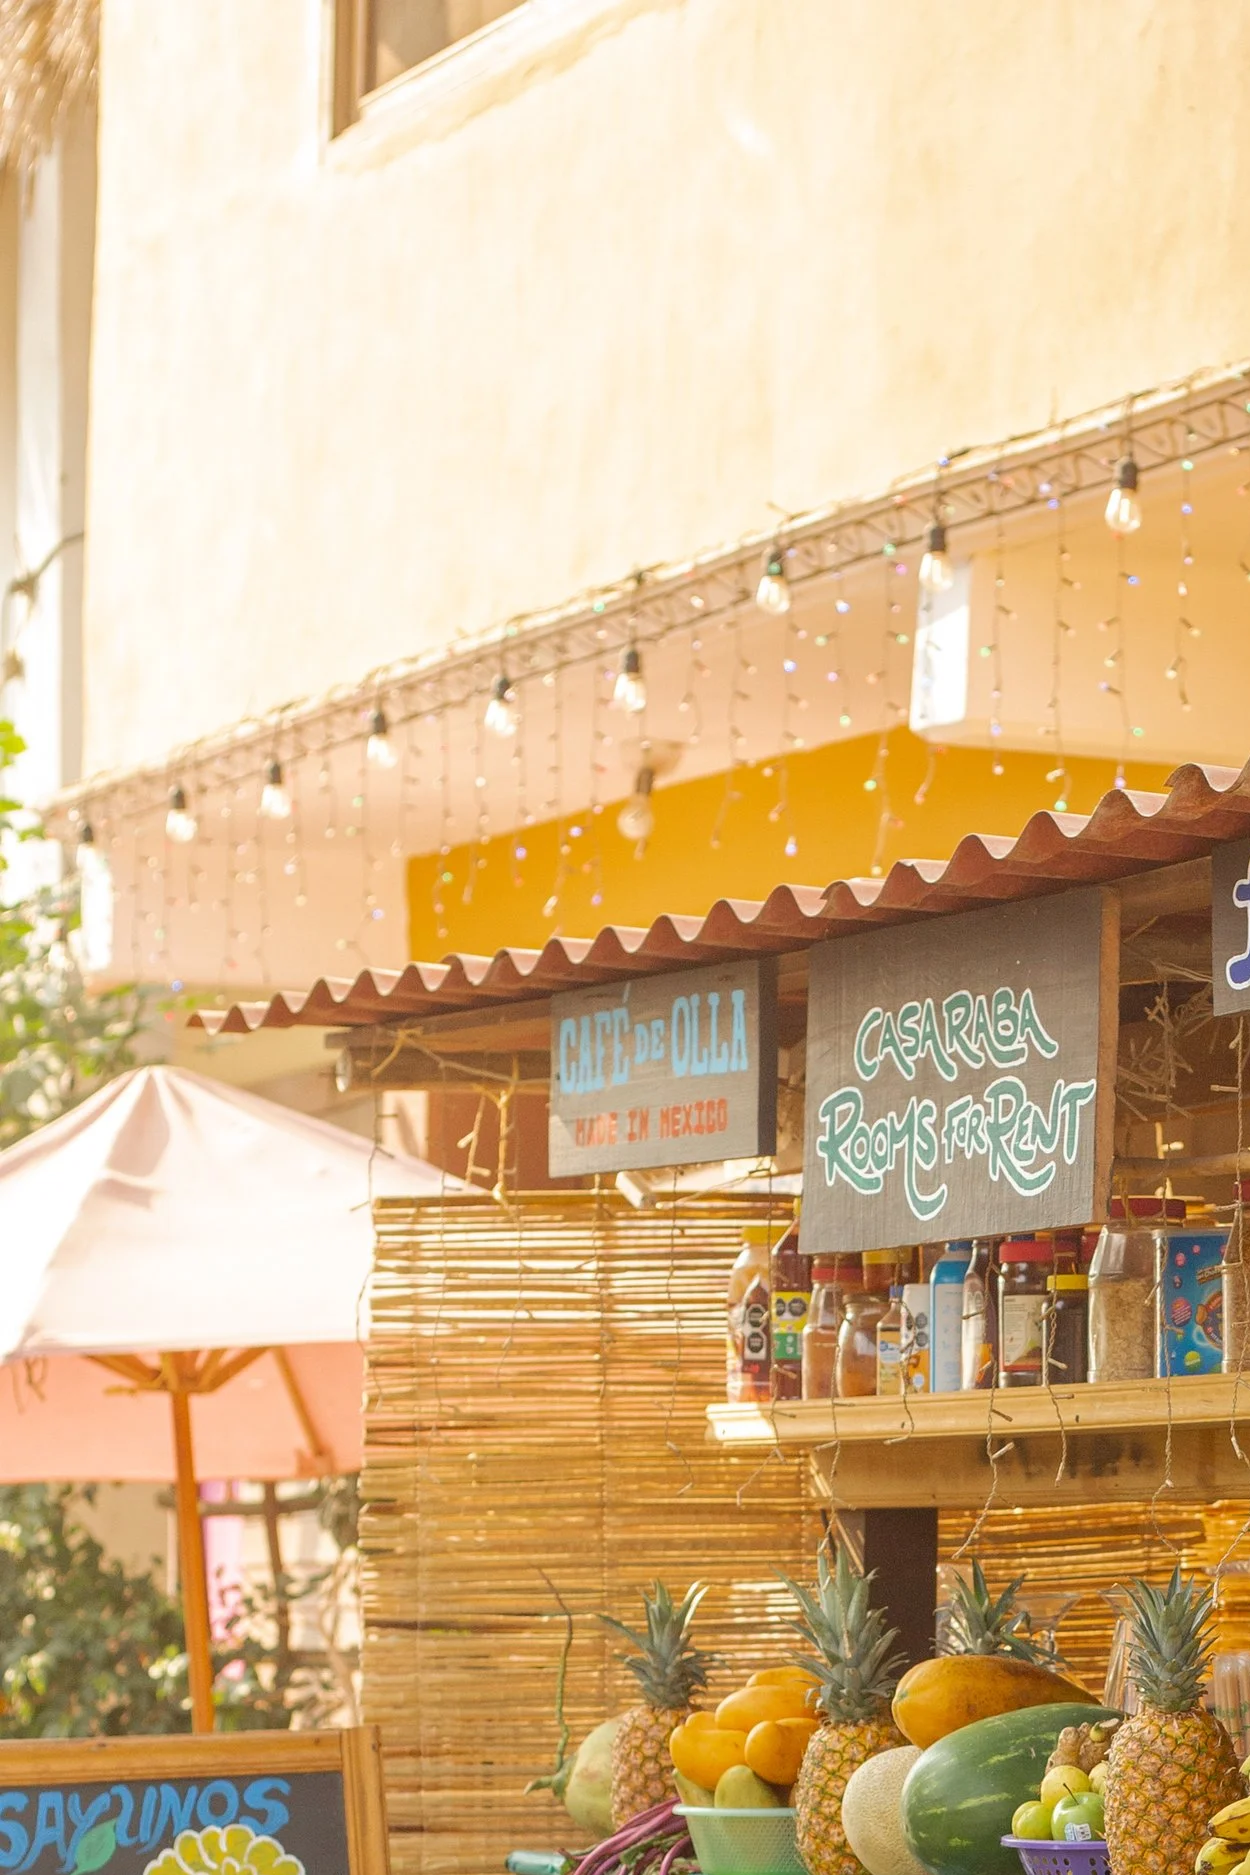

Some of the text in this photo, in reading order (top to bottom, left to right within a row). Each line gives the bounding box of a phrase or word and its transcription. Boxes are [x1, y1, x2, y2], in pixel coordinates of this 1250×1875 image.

[634, 1019, 665, 1065] DE
[671, 989, 748, 1077] OLLA
[575, 1097, 729, 1147] MADE IN MEXICO
